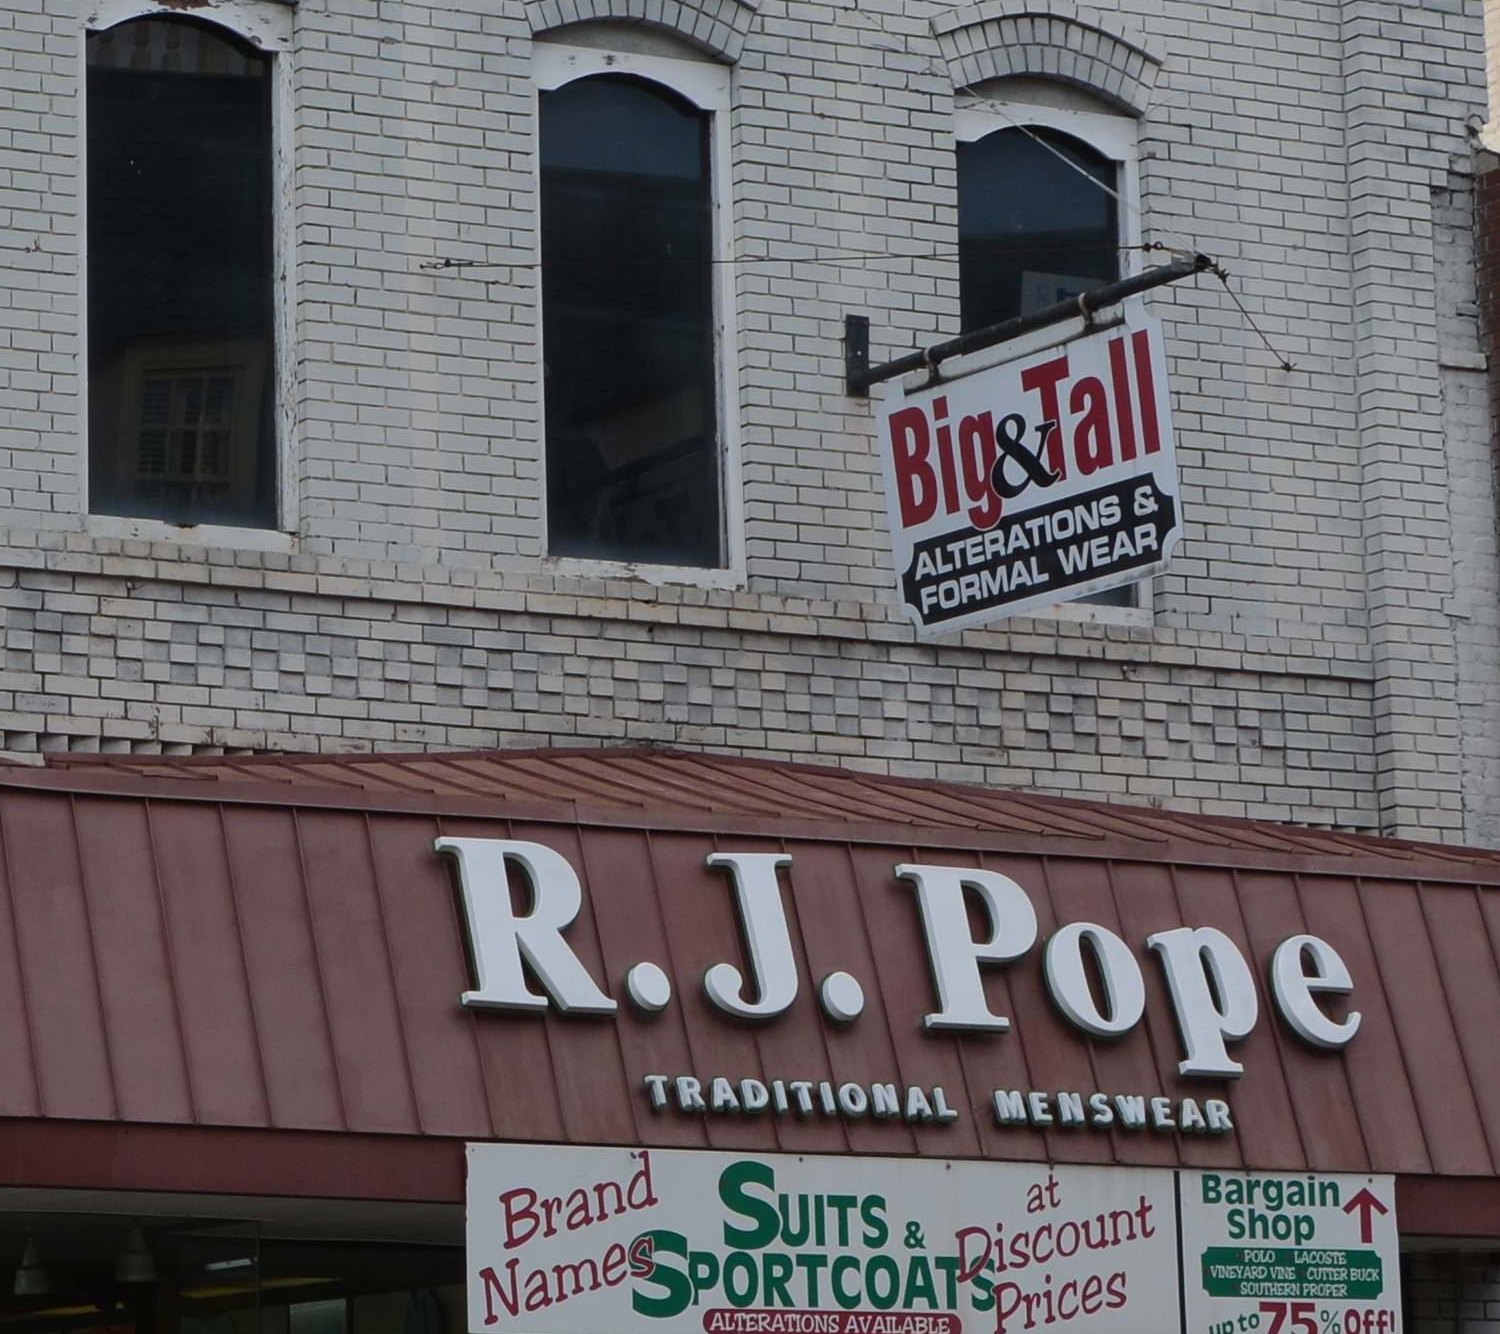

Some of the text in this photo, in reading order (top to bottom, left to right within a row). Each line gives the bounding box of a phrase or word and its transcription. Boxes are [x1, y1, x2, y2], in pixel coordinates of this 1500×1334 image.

[889, 329, 1161, 530] Big & Tall
[914, 485, 1159, 581] ALTERATIONS &
[920, 523, 1159, 615] FORMAL WEAR
[893, 862, 1362, 1080] Pope
[644, 1073, 1236, 1134] TRADITIONAL MENSWEAR
[499, 1150, 659, 1249] Brand
[717, 1160, 926, 1250] SUITS &
[1026, 1174, 1062, 1214] at
[1201, 1174, 1340, 1211] Bargain
[1227, 1208, 1316, 1246] Shop
[479, 1236, 656, 1326] Names
[628, 1229, 999, 1318] SPORTCOATS
[955, 1195, 1157, 1284] Discount
[1210, 1265, 1380, 1282] VINEYARD VINE CUTTER BUCK
[1244, 1249, 1347, 1265] POLO LACOSTE
[1237, 1313, 1260, 1333] to
[1240, 1282, 1348, 1297] SOUTHERN PROPER
